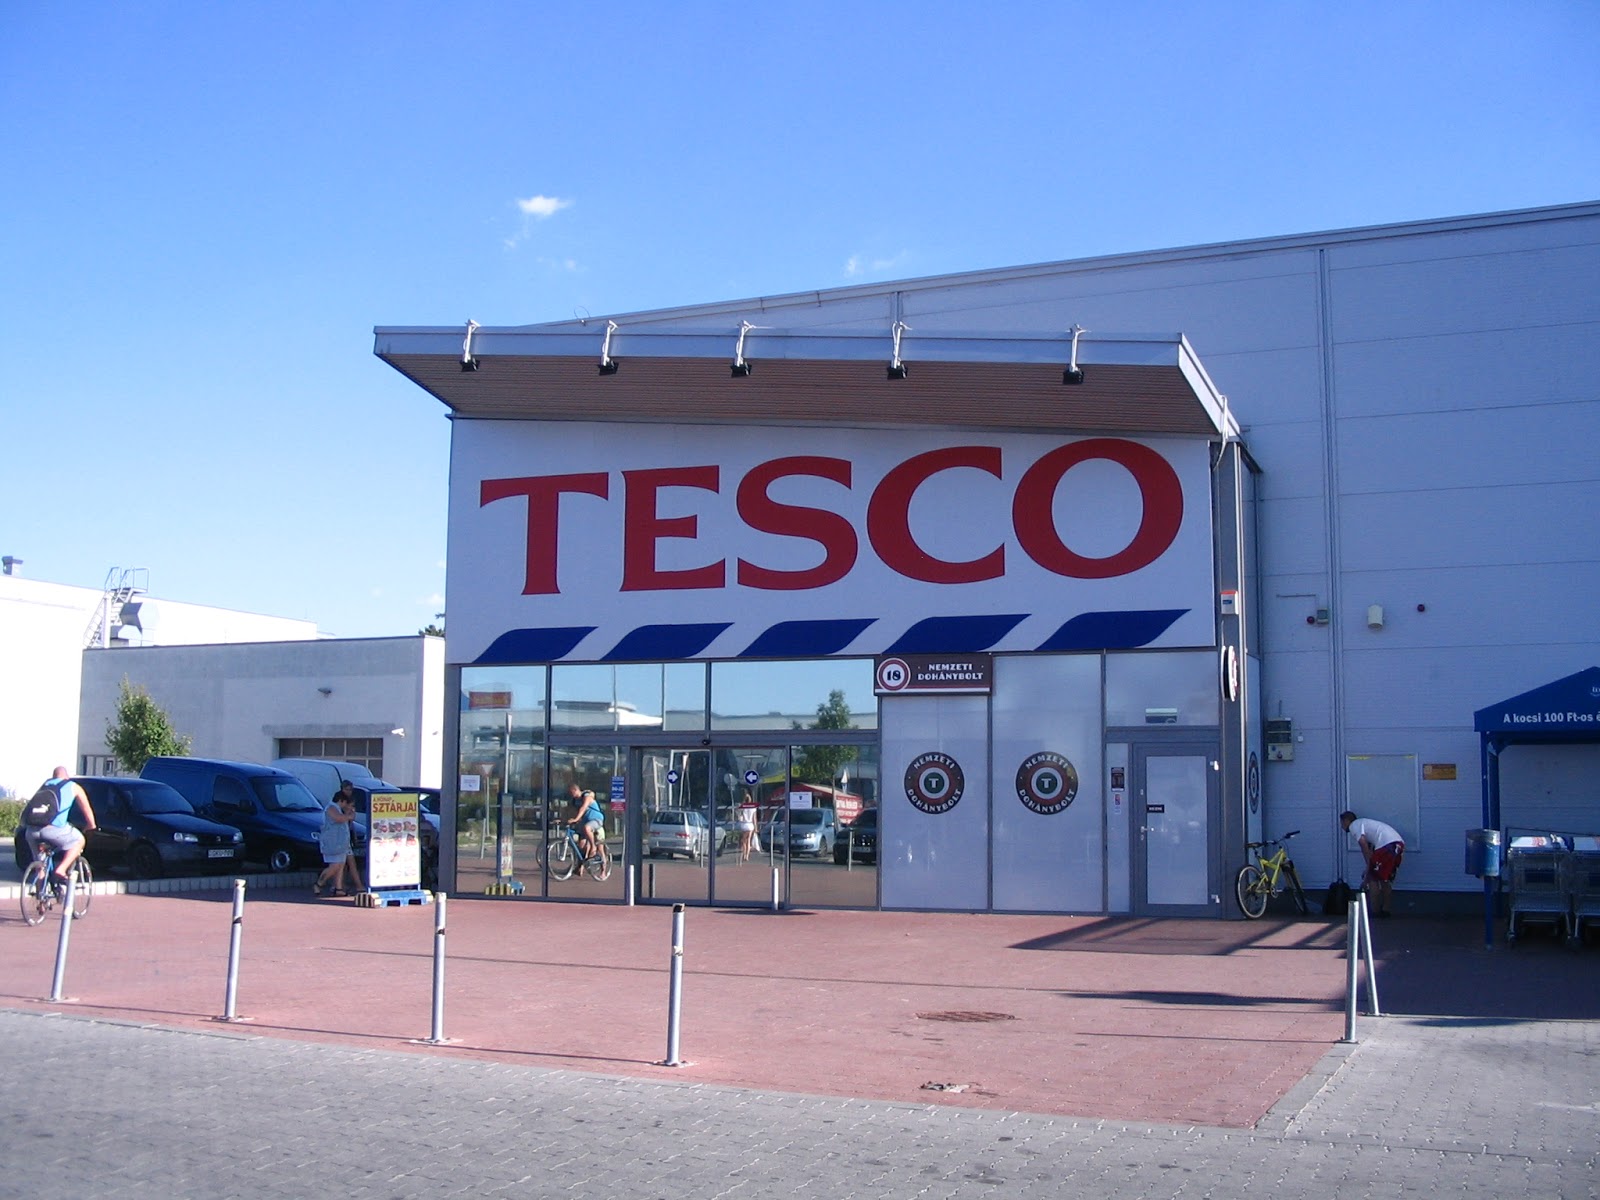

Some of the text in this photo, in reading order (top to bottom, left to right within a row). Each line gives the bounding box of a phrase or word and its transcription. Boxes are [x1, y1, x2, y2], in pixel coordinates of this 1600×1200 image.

[480, 437, 1184, 596] TESCO
[928, 663, 973, 671] NEMZETI
[886, 669, 902, 681] 18
[917, 671, 984, 681] DOHÁNYBOLT
[1503, 713, 1511, 723] A
[1513, 712, 1542, 723] kocsi
[1544, 712, 1564, 723] 100
[1567, 711, 1594, 722] Ft-os
[913, 754, 955, 770] NEMZETI
[1025, 754, 1069, 769] NEMZETI
[928, 778, 939, 789] T
[1040, 778, 1052, 789] T
[372, 800, 416, 812] SZTÁRJAI
[907, 788, 962, 812] DOHÁNYBOLT
[1019, 788, 1075, 813] DOHÁNYBOLT
